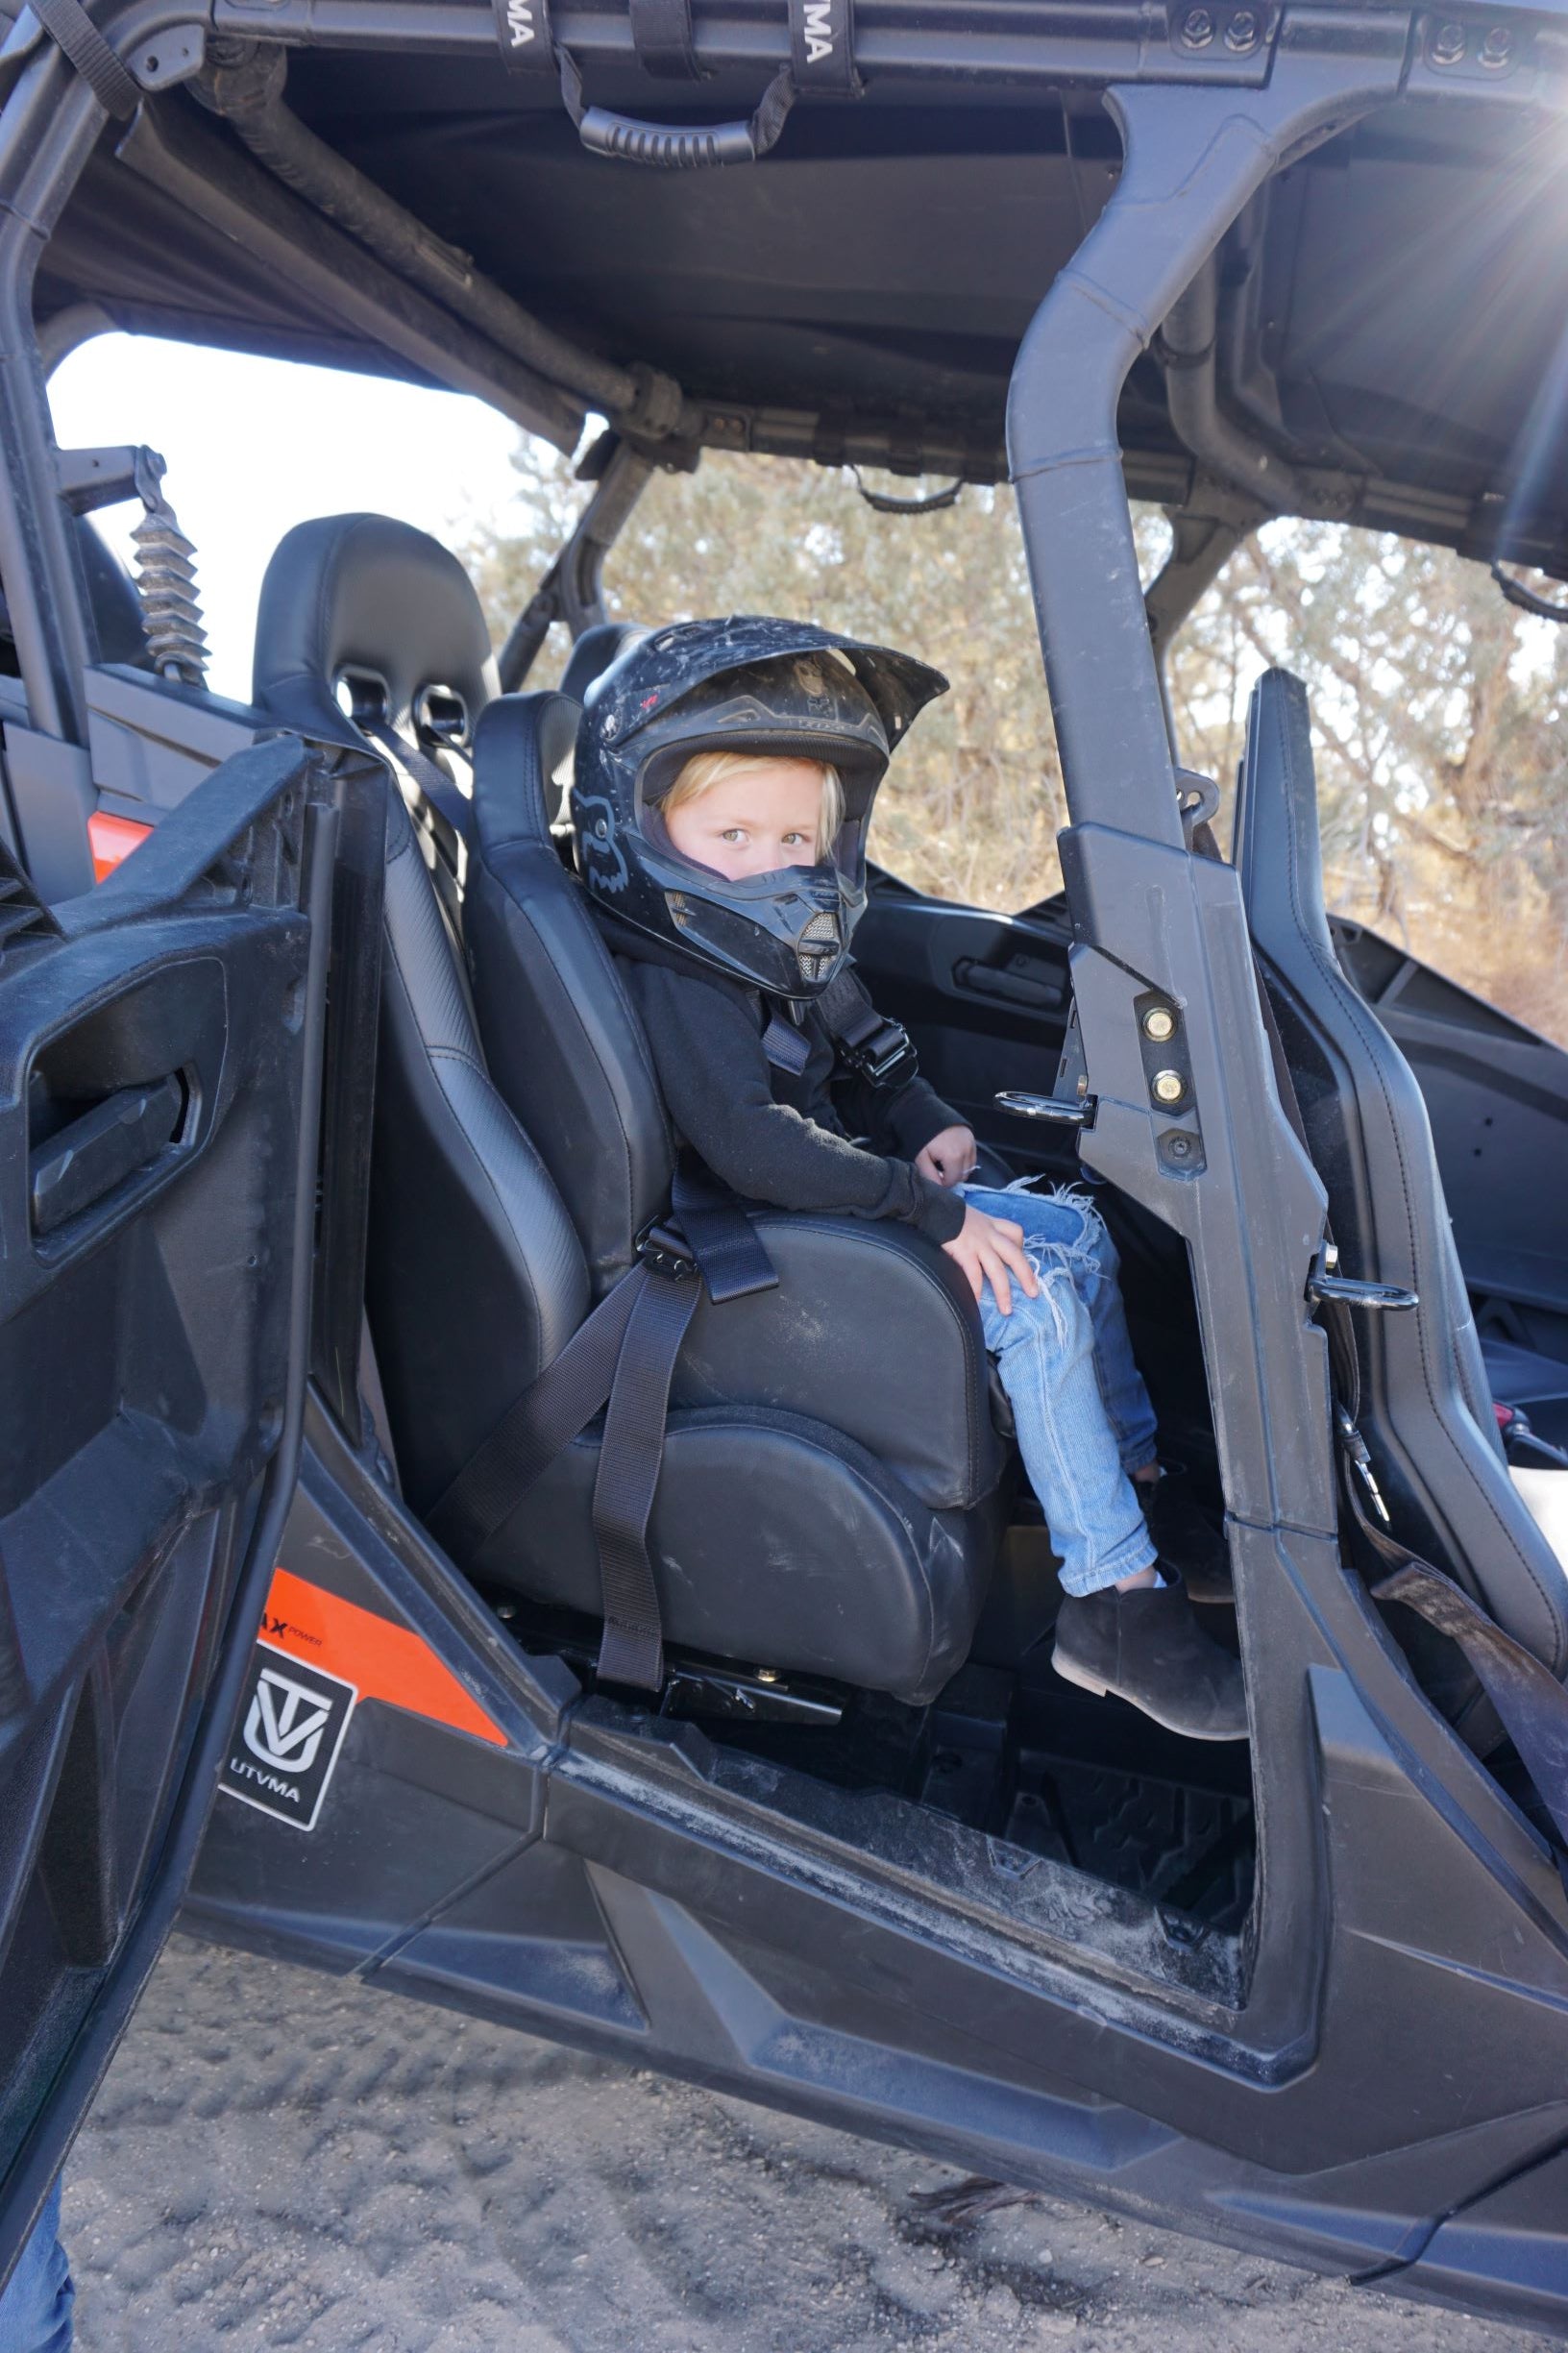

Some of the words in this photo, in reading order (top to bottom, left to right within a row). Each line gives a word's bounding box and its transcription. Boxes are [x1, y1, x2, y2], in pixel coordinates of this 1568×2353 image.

[803, 0, 833, 64] MA
[288, 1626, 323, 1646] POWER
[230, 1756, 301, 1803] UTVMA
